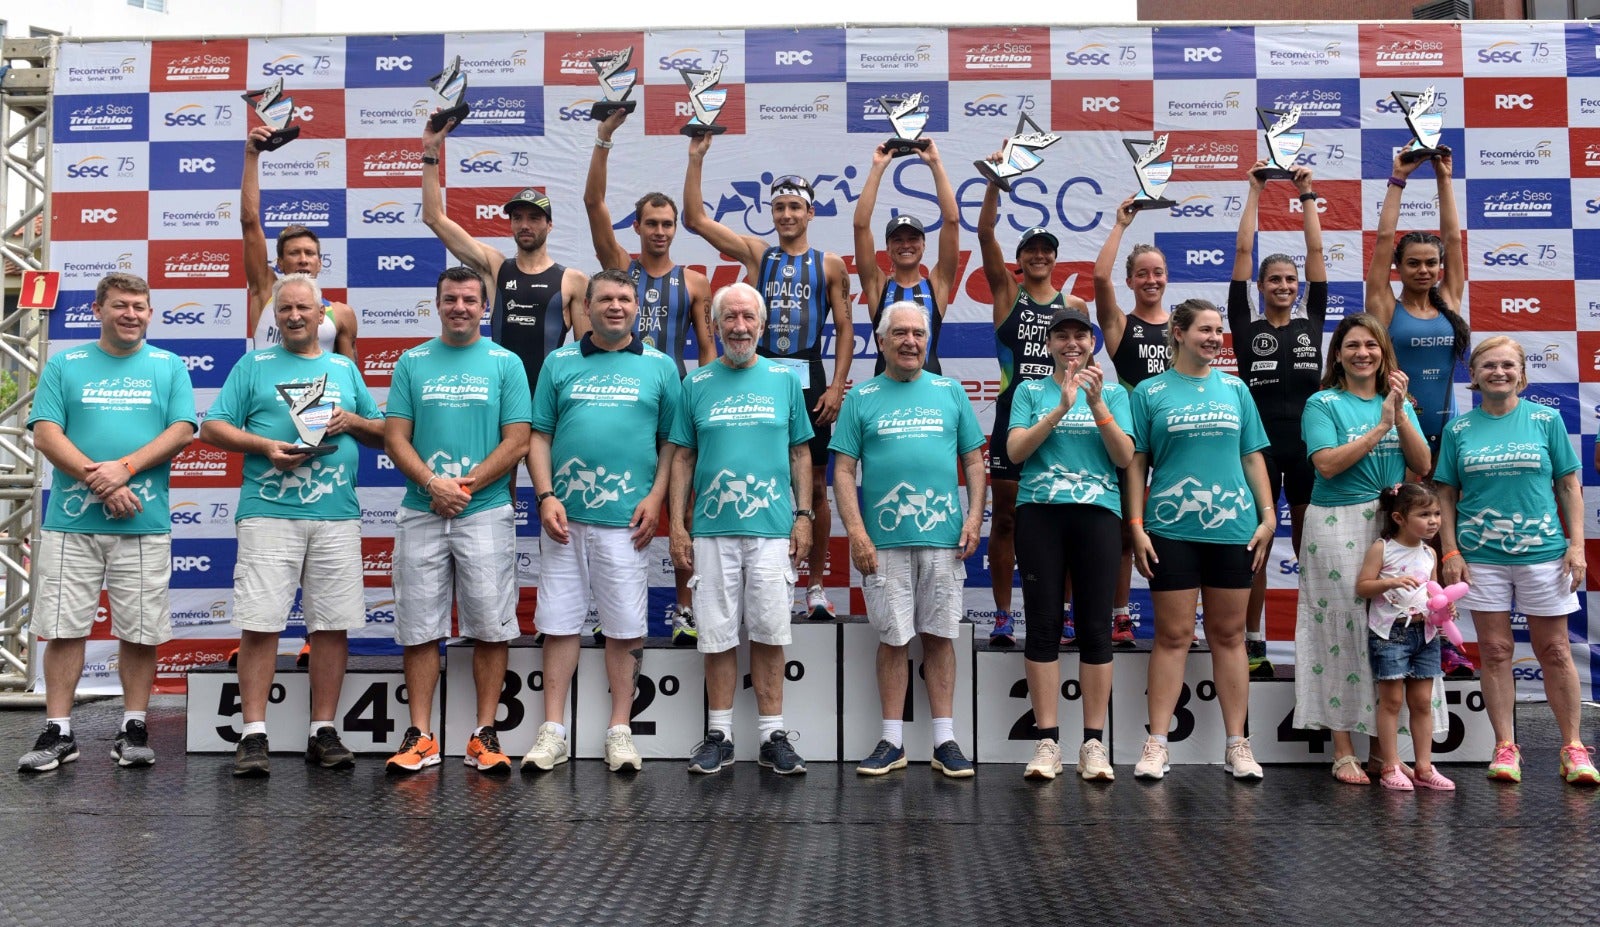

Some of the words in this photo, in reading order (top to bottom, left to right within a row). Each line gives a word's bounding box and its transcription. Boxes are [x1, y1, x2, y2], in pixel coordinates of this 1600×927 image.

[1004, 43, 1032, 53] Sesc
[1414, 40, 1442, 50] Sesc
[776, 50, 813, 65] RPC
[860, 53, 914, 61] Fecomércio
[918, 53, 930, 61] PR
[966, 54, 1032, 62] Triathlon
[1066, 52, 1110, 65] Sesc
[1119, 46, 1136, 60] 75
[1184, 47, 1222, 62] RPC
[1271, 50, 1324, 59] Fecomércio
[1328, 51, 1340, 59] PR
[1478, 50, 1522, 63] Sesc
[1530, 43, 1549, 57] 75
[204, 55, 230, 64] Sesc
[376, 56, 413, 71] RPC
[514, 58, 526, 66] PR
[659, 56, 702, 70] Sesc
[712, 50, 729, 64] 75
[69, 67, 120, 75] Fecomércio
[166, 66, 230, 74] Triathlon
[262, 62, 304, 76] Sesc
[313, 56, 331, 69] 75
[1312, 90, 1341, 100] Sesc
[498, 97, 525, 108] Sesc
[964, 102, 1007, 116] Sesc
[1016, 96, 1035, 110] 75
[1082, 96, 1120, 112] RPC
[1169, 100, 1223, 109] Fecomércio
[1226, 100, 1239, 108] PR
[1274, 102, 1341, 110] Triathlon
[1495, 94, 1533, 109] RPC
[106, 104, 133, 114] Sesc
[361, 109, 412, 117] Fecomércio
[416, 109, 428, 117] PR
[760, 104, 813, 112] Fecomércio
[816, 104, 828, 112] PR
[70, 116, 132, 124] Triathlon
[165, 112, 206, 126] Sesc
[215, 106, 232, 119] 75
[1210, 142, 1238, 152] Sesc
[1326, 145, 1344, 159] 75
[1173, 154, 1238, 162] Triathlon
[1480, 150, 1535, 158] Fecomércio
[1538, 150, 1551, 158] PR
[67, 164, 108, 178] Sesc
[117, 157, 135, 171] 75
[179, 158, 216, 172] RPC
[262, 161, 314, 169] Fecomércio
[460, 159, 502, 172] Sesc
[511, 152, 529, 166] 75
[891, 158, 1103, 233] Sesc
[1523, 190, 1552, 200] Sesc
[302, 200, 329, 211] Sesc
[1170, 204, 1214, 217] Sesc
[1224, 196, 1241, 210] 75
[1289, 198, 1327, 213] RC
[1484, 202, 1552, 210] Triathlon
[81, 208, 117, 223] RPC
[218, 211, 231, 219] PR
[265, 212, 329, 220] Triathlon
[363, 210, 404, 223] Sesc
[202, 252, 230, 261] Sesc
[1186, 250, 1224, 265] RPC
[1331, 253, 1344, 261] PR
[1483, 252, 1528, 266] Sesc
[1538, 245, 1556, 259] 75
[64, 262, 116, 270] Fecomércio
[164, 263, 229, 271] Triathlon
[378, 255, 415, 271] RPC
[765, 280, 811, 299] HIDALGO
[770, 300, 802, 309] DUX
[1501, 298, 1540, 313] RPC
[163, 310, 205, 324] Sesc
[214, 304, 232, 318] 75
[363, 309, 415, 317] Fecomércio
[418, 308, 430, 316] PR
[638, 318, 661, 331] BRA
[1411, 336, 1454, 347] DESIREE
[556, 350, 580, 358] Sesc
[1024, 342, 1049, 357] BRA
[1546, 353, 1559, 361] PR
[1023, 365, 1051, 374] SESI
[1148, 359, 1165, 373] BRA
[124, 377, 152, 388] Sesc
[461, 373, 489, 384] Sesc
[612, 374, 640, 386] Sesc
[692, 372, 714, 383] Sesc
[82, 388, 152, 397] Triathlon
[422, 384, 488, 393] Triathlon
[570, 385, 639, 394] Triathlon
[1148, 383, 1167, 395] Sesc
[747, 393, 774, 404] Sesc
[1530, 395, 1560, 406] Sesc
[710, 405, 775, 415] Triathlon
[915, 407, 942, 416] Sesc
[1209, 401, 1238, 413] Sesc
[878, 418, 943, 428] Triathlon
[1166, 413, 1238, 424] Triathlon
[1508, 442, 1540, 451] Sesc
[199, 450, 227, 460] Sesc
[1464, 452, 1540, 465] Triathlon
[210, 504, 228, 518] 75
[173, 556, 210, 571] RPC
[212, 610, 226, 618] PR
[195, 652, 224, 662] Sesc
